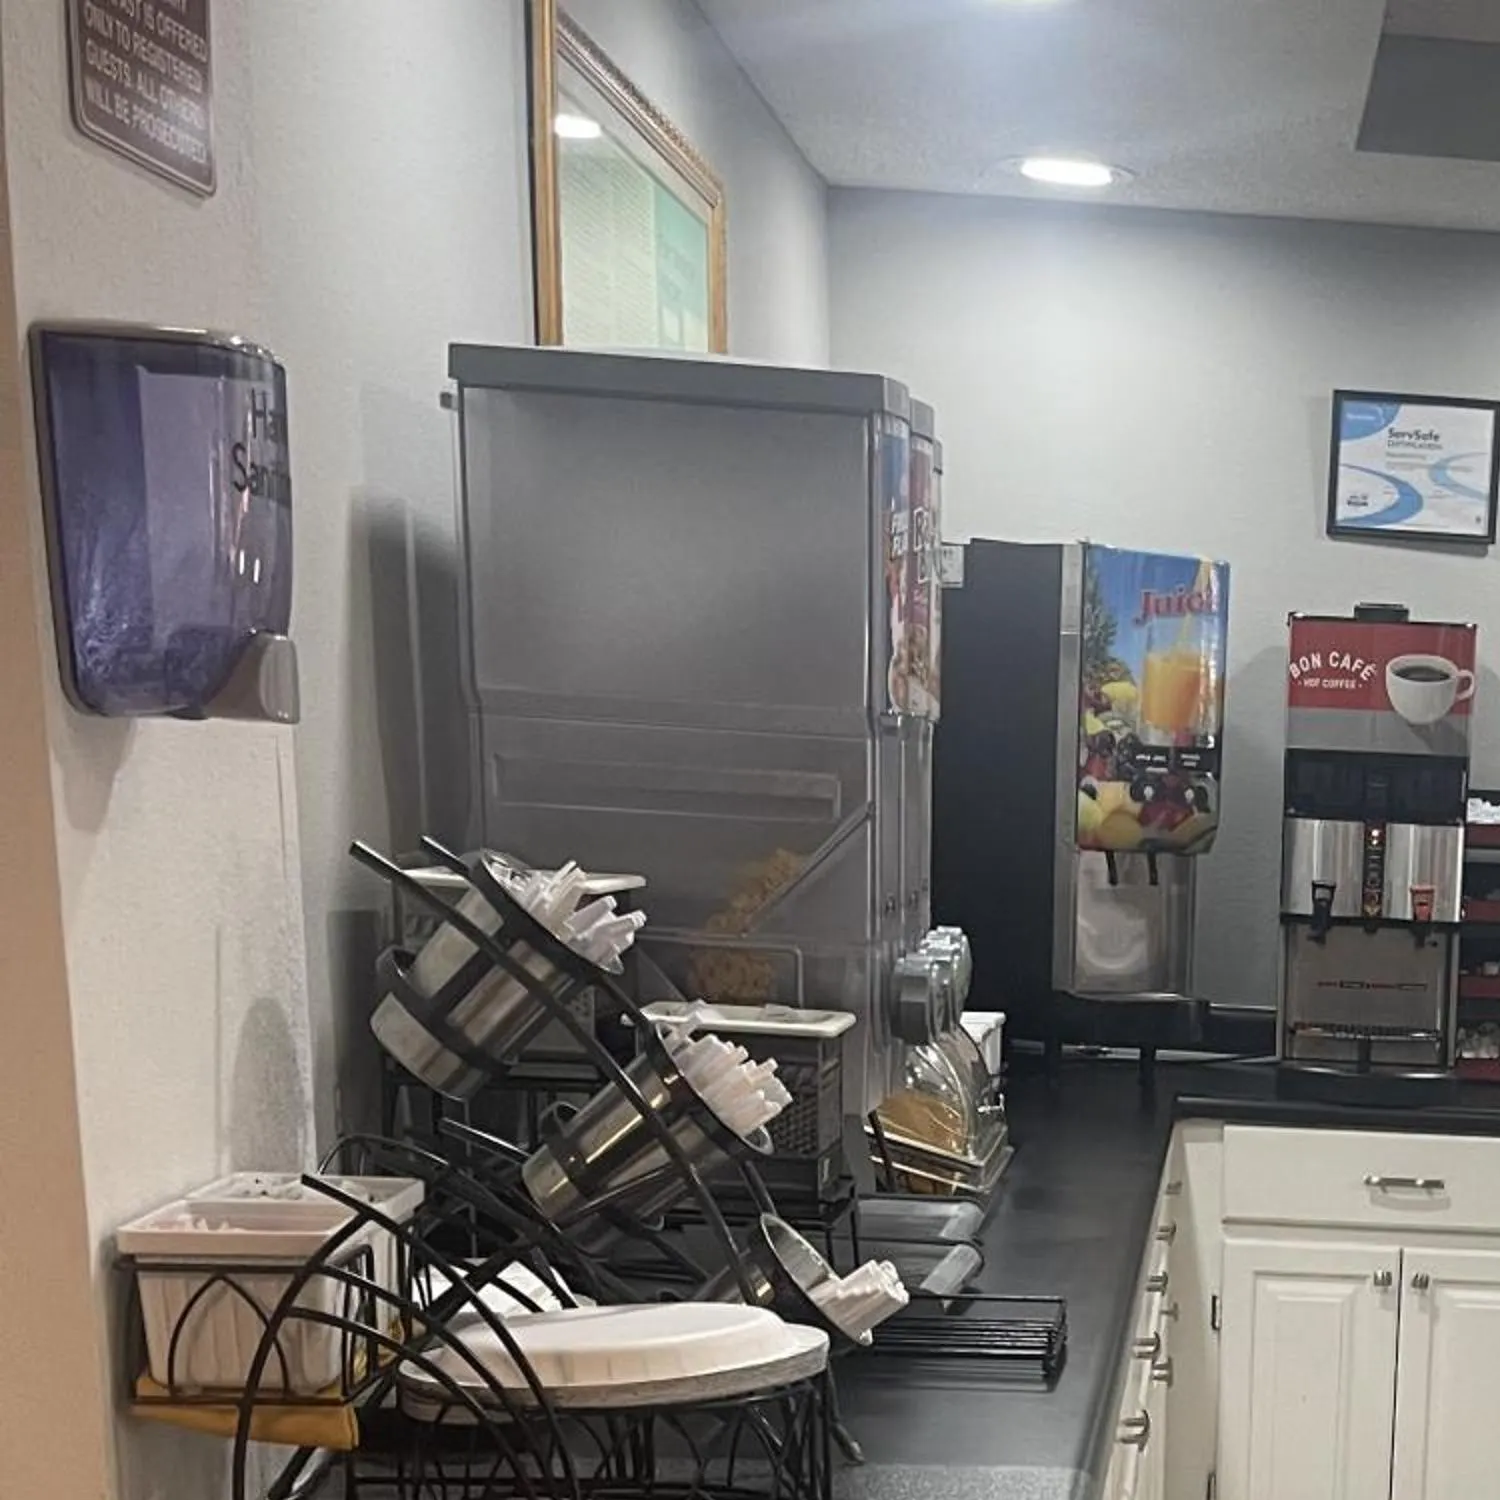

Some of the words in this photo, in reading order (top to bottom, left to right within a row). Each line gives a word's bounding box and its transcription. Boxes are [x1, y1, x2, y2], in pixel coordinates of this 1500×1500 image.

[84, 0, 113, 39] ONLY
[115, 19, 131, 51] TO
[132, 31, 203, 93] REGISTERED
[156, 11, 207, 63] OFFERED
[84, 76, 113, 115] WILL
[114, 93, 130, 125] BE
[137, 70, 158, 104] ALL
[1387, 427, 1440, 442] ServSafe
[1289, 652, 1321, 679] BON
[1321, 679, 1356, 689] COFFEE
